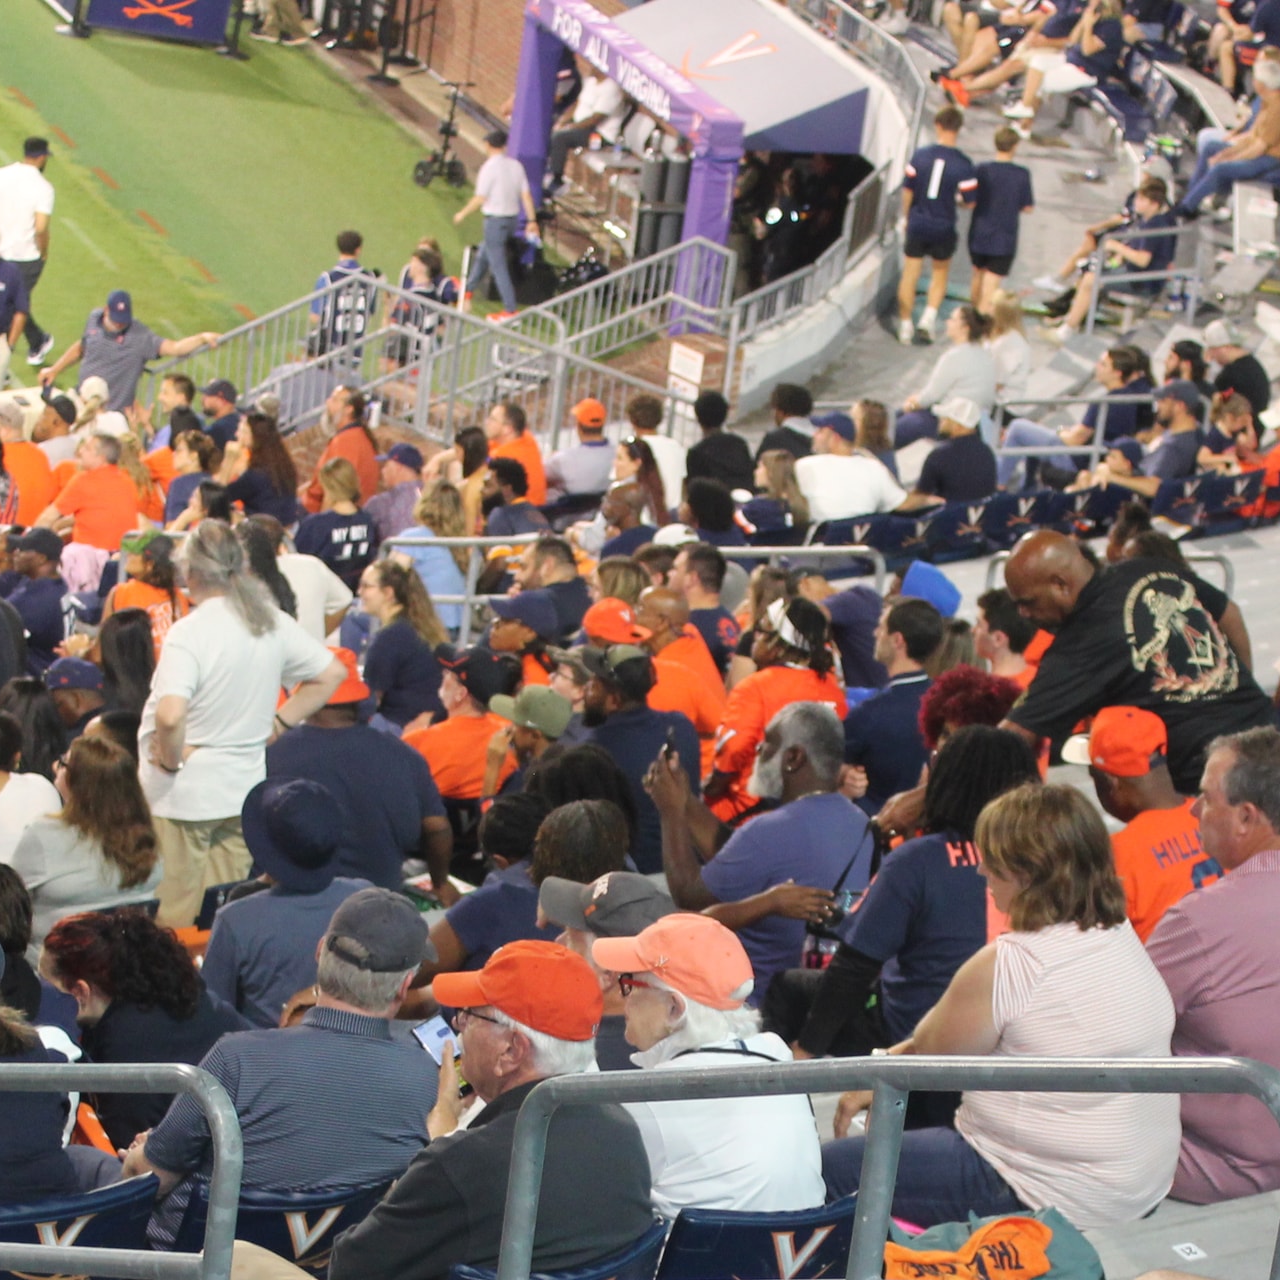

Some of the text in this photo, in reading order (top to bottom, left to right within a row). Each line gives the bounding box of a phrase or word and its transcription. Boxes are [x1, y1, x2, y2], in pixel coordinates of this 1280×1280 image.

[553, 5, 583, 49] FOR
[584, 34, 610, 73] ALL
[616, 55, 671, 119] VIRGINIA
[283, 1204, 346, 1260] V
[771, 1224, 838, 1280] V
